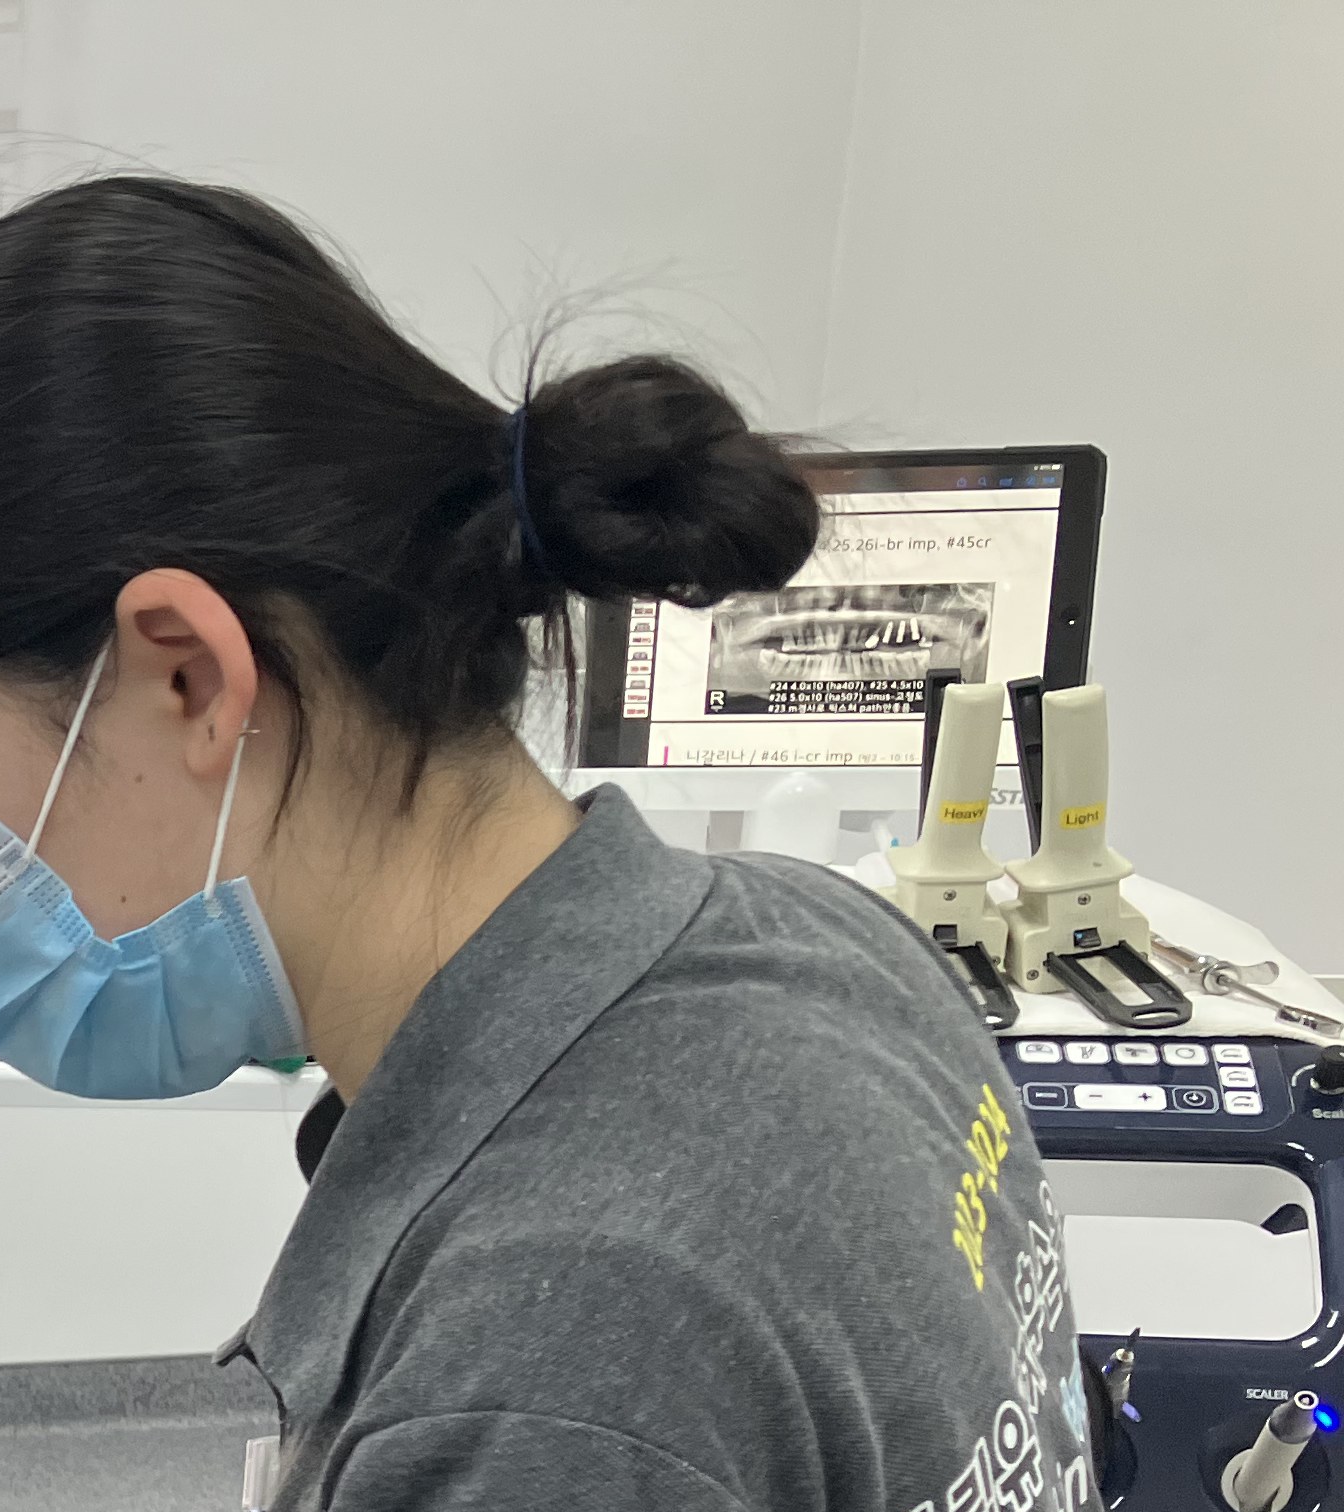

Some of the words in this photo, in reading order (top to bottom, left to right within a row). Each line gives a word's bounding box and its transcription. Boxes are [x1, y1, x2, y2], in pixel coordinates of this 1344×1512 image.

[947, 536, 992, 549] #45cr
[769, 682, 788, 691] #24
[791, 681, 823, 691] 4.0x10
[870, 680, 888, 690] #25
[890, 680, 924, 690] 4.5x10
[710, 691, 725, 705] R
[761, 751, 789, 762] #46
[826, 751, 853, 765] imp
[944, 807, 984, 820] Heavy
[1066, 811, 1099, 825] Light
[1246, 1388, 1288, 1400] SCALER
